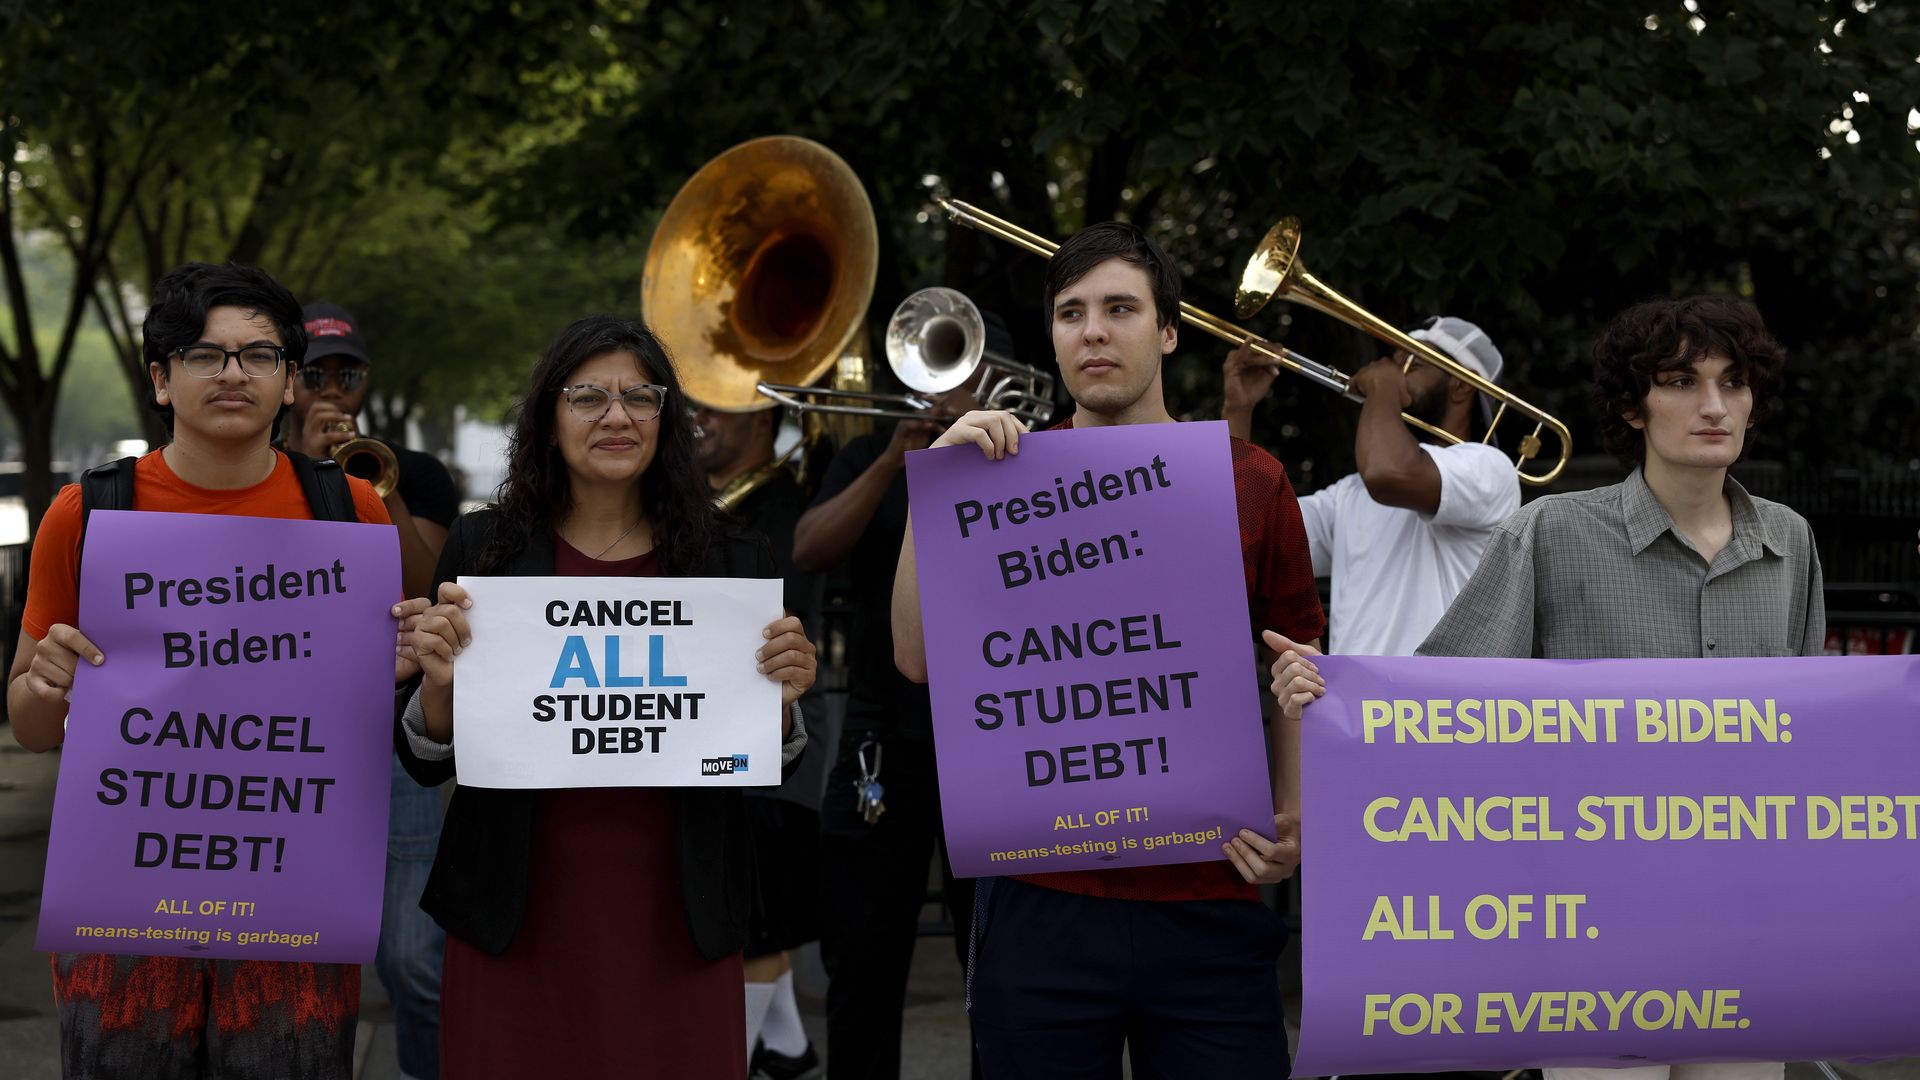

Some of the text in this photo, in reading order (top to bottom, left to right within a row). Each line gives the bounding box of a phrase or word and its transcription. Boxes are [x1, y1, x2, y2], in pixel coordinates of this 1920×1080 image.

[954, 455, 1171, 539] President
[997, 529, 1144, 589] Biden:
[126, 559, 346, 609] President
[546, 600, 693, 626] CANCEL
[163, 629, 311, 668] Biden:
[550, 634, 688, 688] ALL
[983, 614, 1181, 667] CANCEL
[533, 693, 705, 721] STUDENT
[974, 671, 1199, 731] STUDENT
[1363, 699, 1792, 743] PRESIDENT BIDEN:
[121, 708, 324, 752] CANCEL
[573, 727, 666, 754] DEBT
[702, 757, 748, 773] MOVEON
[1026, 737, 1168, 786] DEBT!
[97, 768, 335, 813] STUDENT
[1054, 807, 1149, 831] ALL OF IT!
[1364, 796, 1920, 842] CANCEL STUDENT DEBT
[135, 832, 285, 872] DEBT!
[990, 826, 1223, 861] means-testing is garbage!
[154, 899, 255, 916] ALL OF IT!
[1363, 895, 1598, 940] ALL OF IT.
[75, 926, 320, 948] means-testing is garbage!
[1364, 990, 1750, 1035] FOR EVERYONE.
